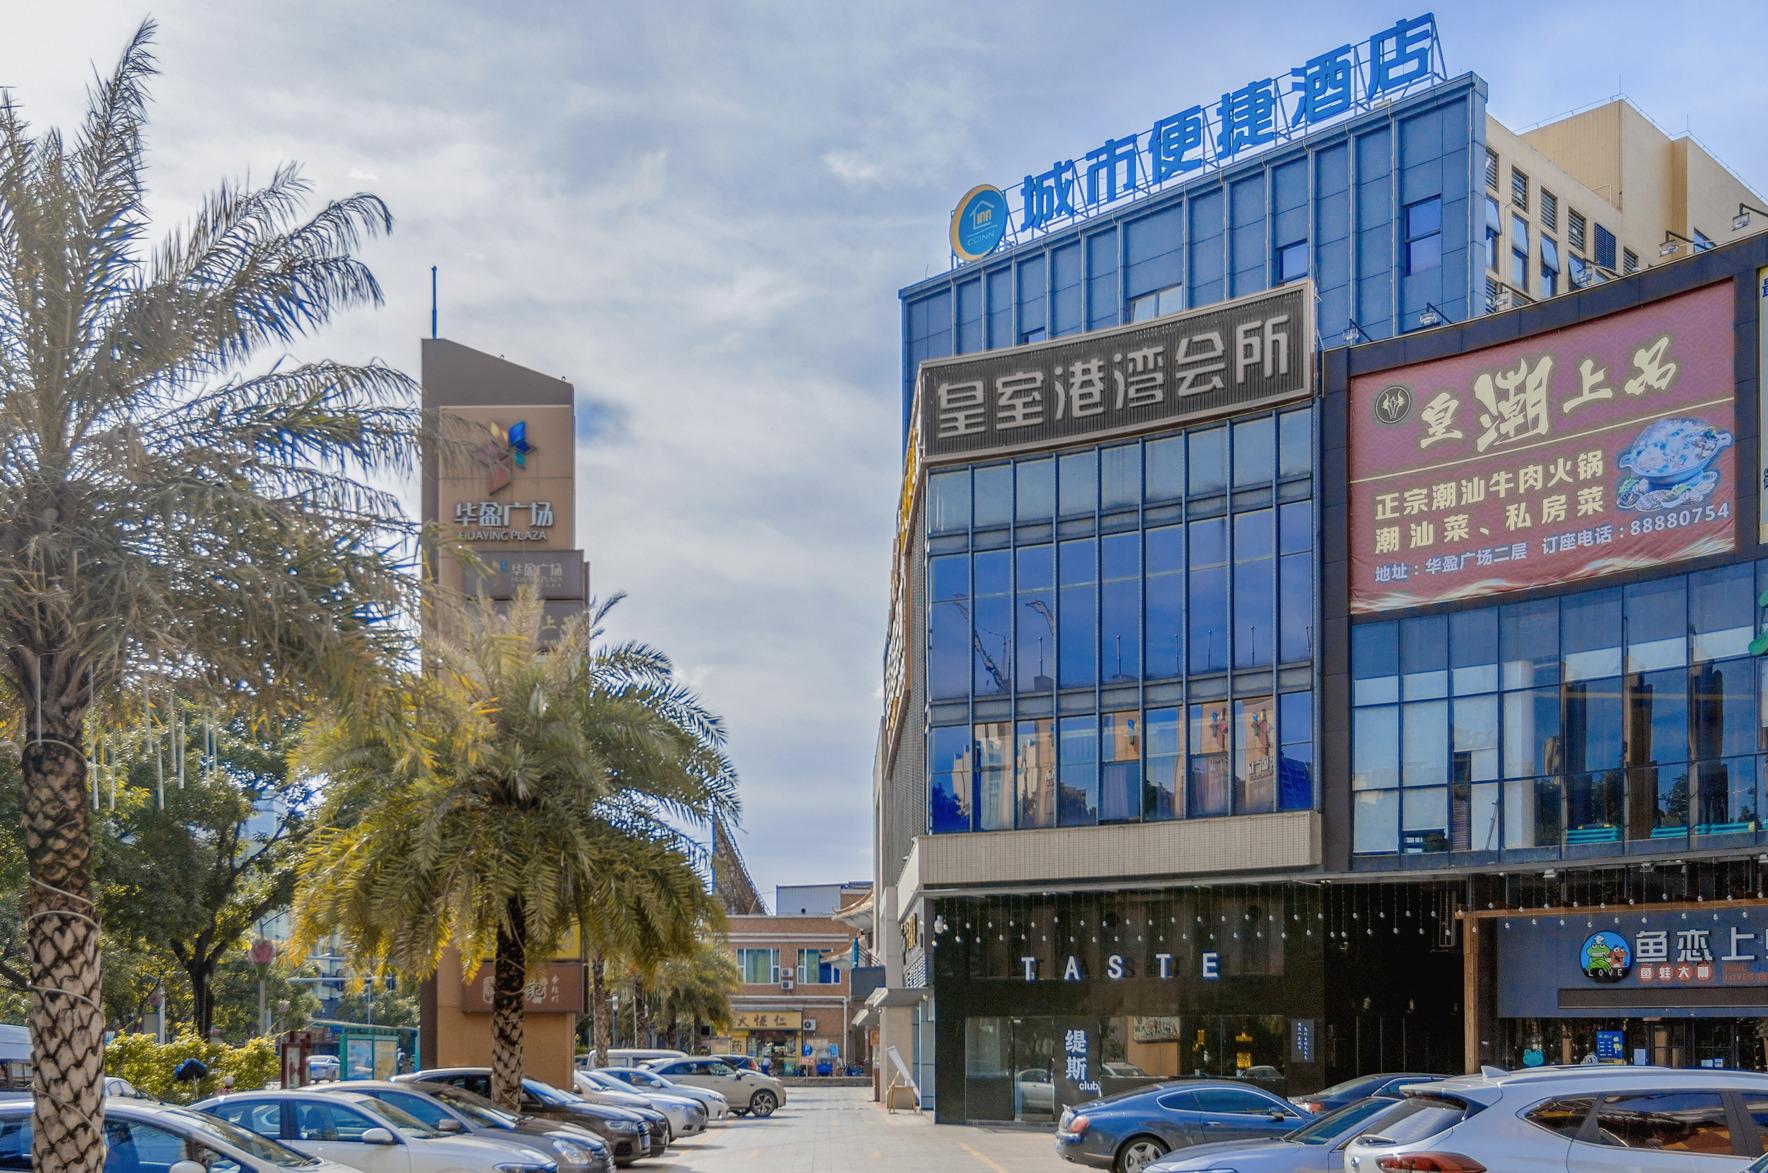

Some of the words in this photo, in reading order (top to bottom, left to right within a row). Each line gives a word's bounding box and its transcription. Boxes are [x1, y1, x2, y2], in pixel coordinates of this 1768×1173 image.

[1020, 13, 1434, 232] 城市便捷酒店
[937, 314, 1290, 438] 皇室港湾会所
[1375, 450, 1604, 521] 正宗潮汕牛肉火锅
[455, 502, 554, 527] 华盈广场
[1375, 486, 1604, 554] 潮汕菜、私房菜
[511, 531, 546, 541] PLAZA
[1636, 926, 1768, 962] 鱼恋上
[1021, 952, 1220, 982] TASTE
[1079, 1081, 1099, 1091] club
